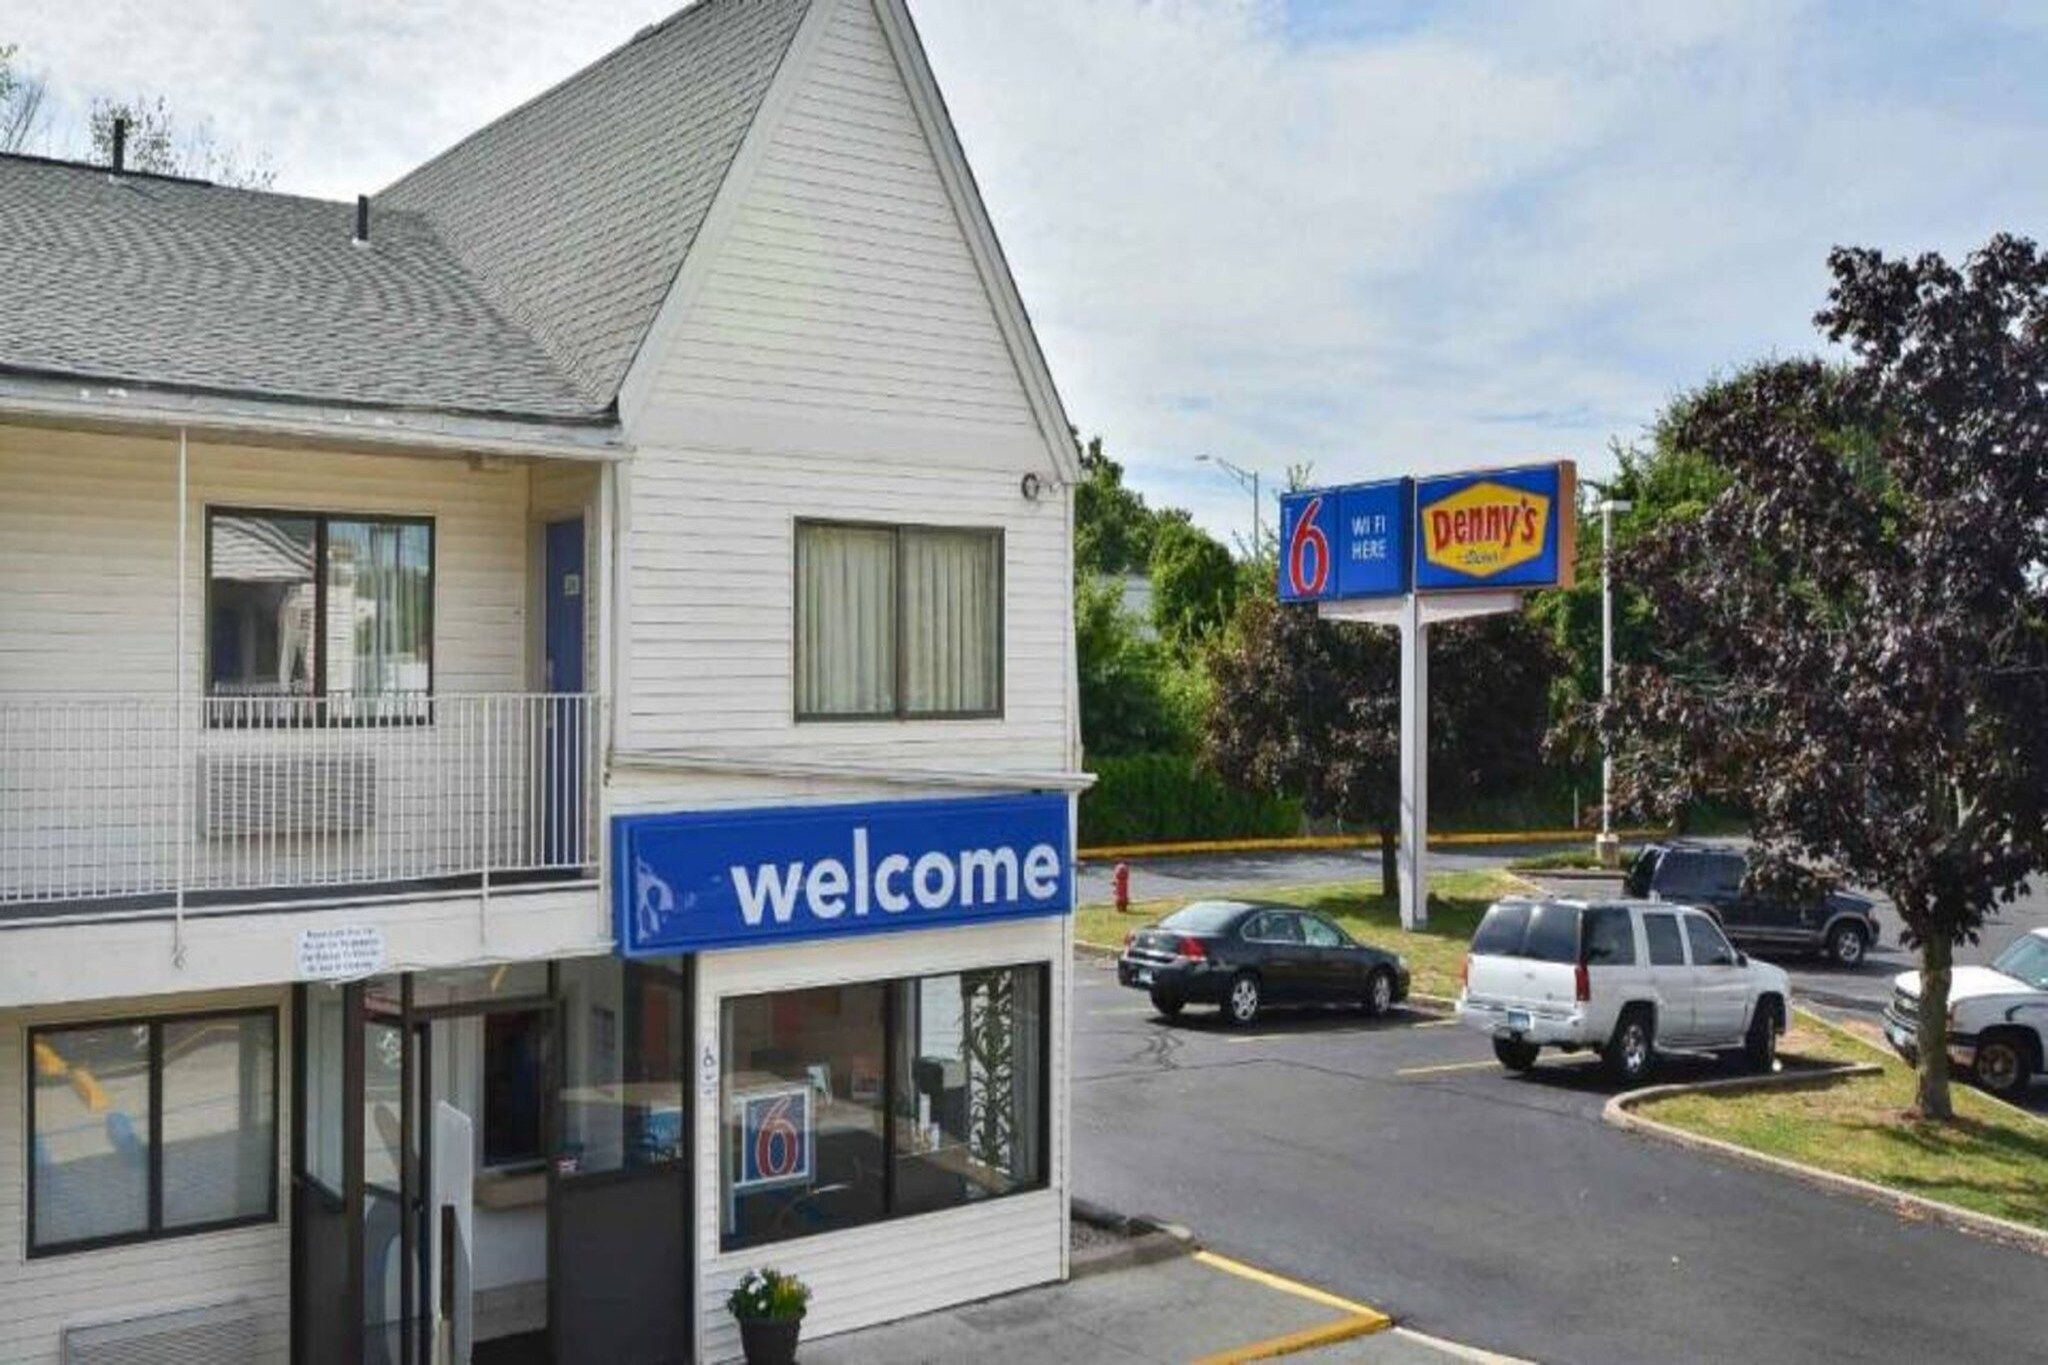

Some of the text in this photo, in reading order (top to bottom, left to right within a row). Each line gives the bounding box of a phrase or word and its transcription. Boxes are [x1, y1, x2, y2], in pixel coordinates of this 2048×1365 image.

[1288, 497, 1329, 596] 6
[1351, 539, 1386, 560] HERE
[1432, 498, 1537, 550] Denny's
[731, 827, 1059, 925] welcome
[755, 1095, 798, 1178] 6
